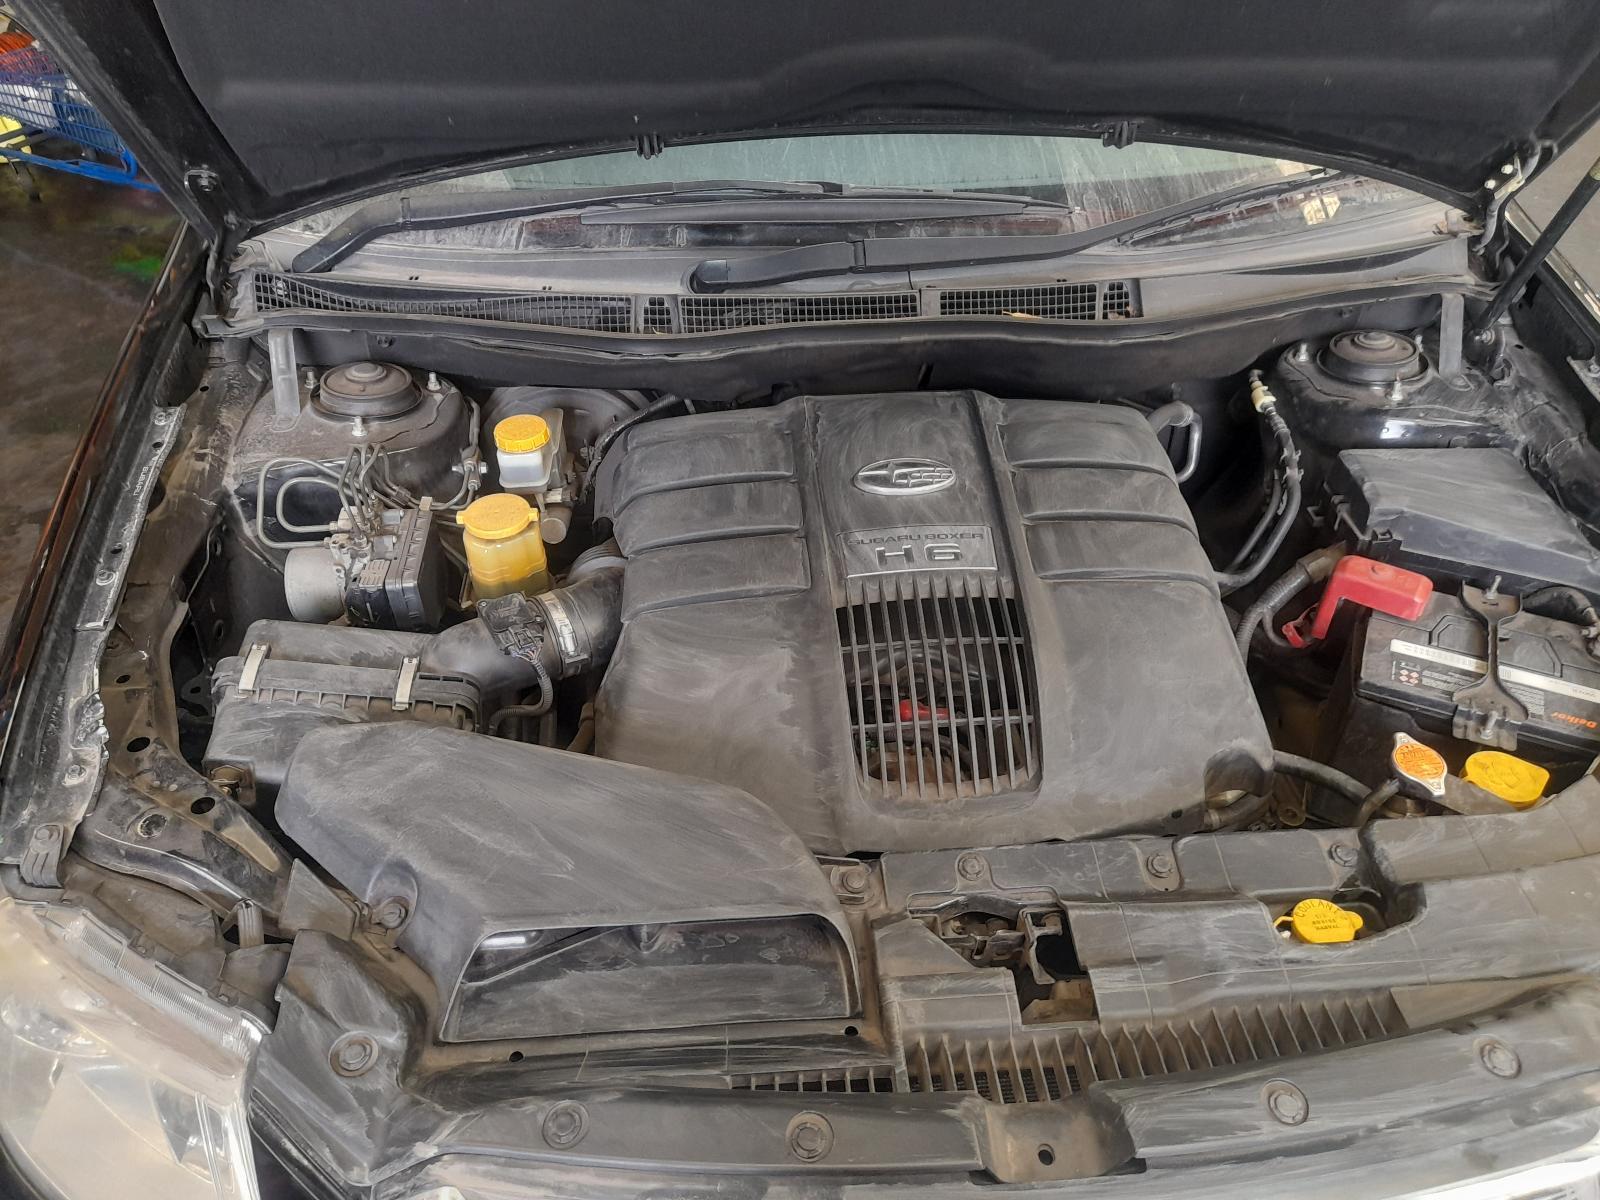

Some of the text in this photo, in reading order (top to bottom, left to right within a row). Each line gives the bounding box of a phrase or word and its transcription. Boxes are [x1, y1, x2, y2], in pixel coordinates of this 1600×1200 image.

[848, 532, 984, 546] SUBARU BOXER
[1551, 711, 1598, 730] Delkor
[1295, 900, 1342, 918] COOLANT
